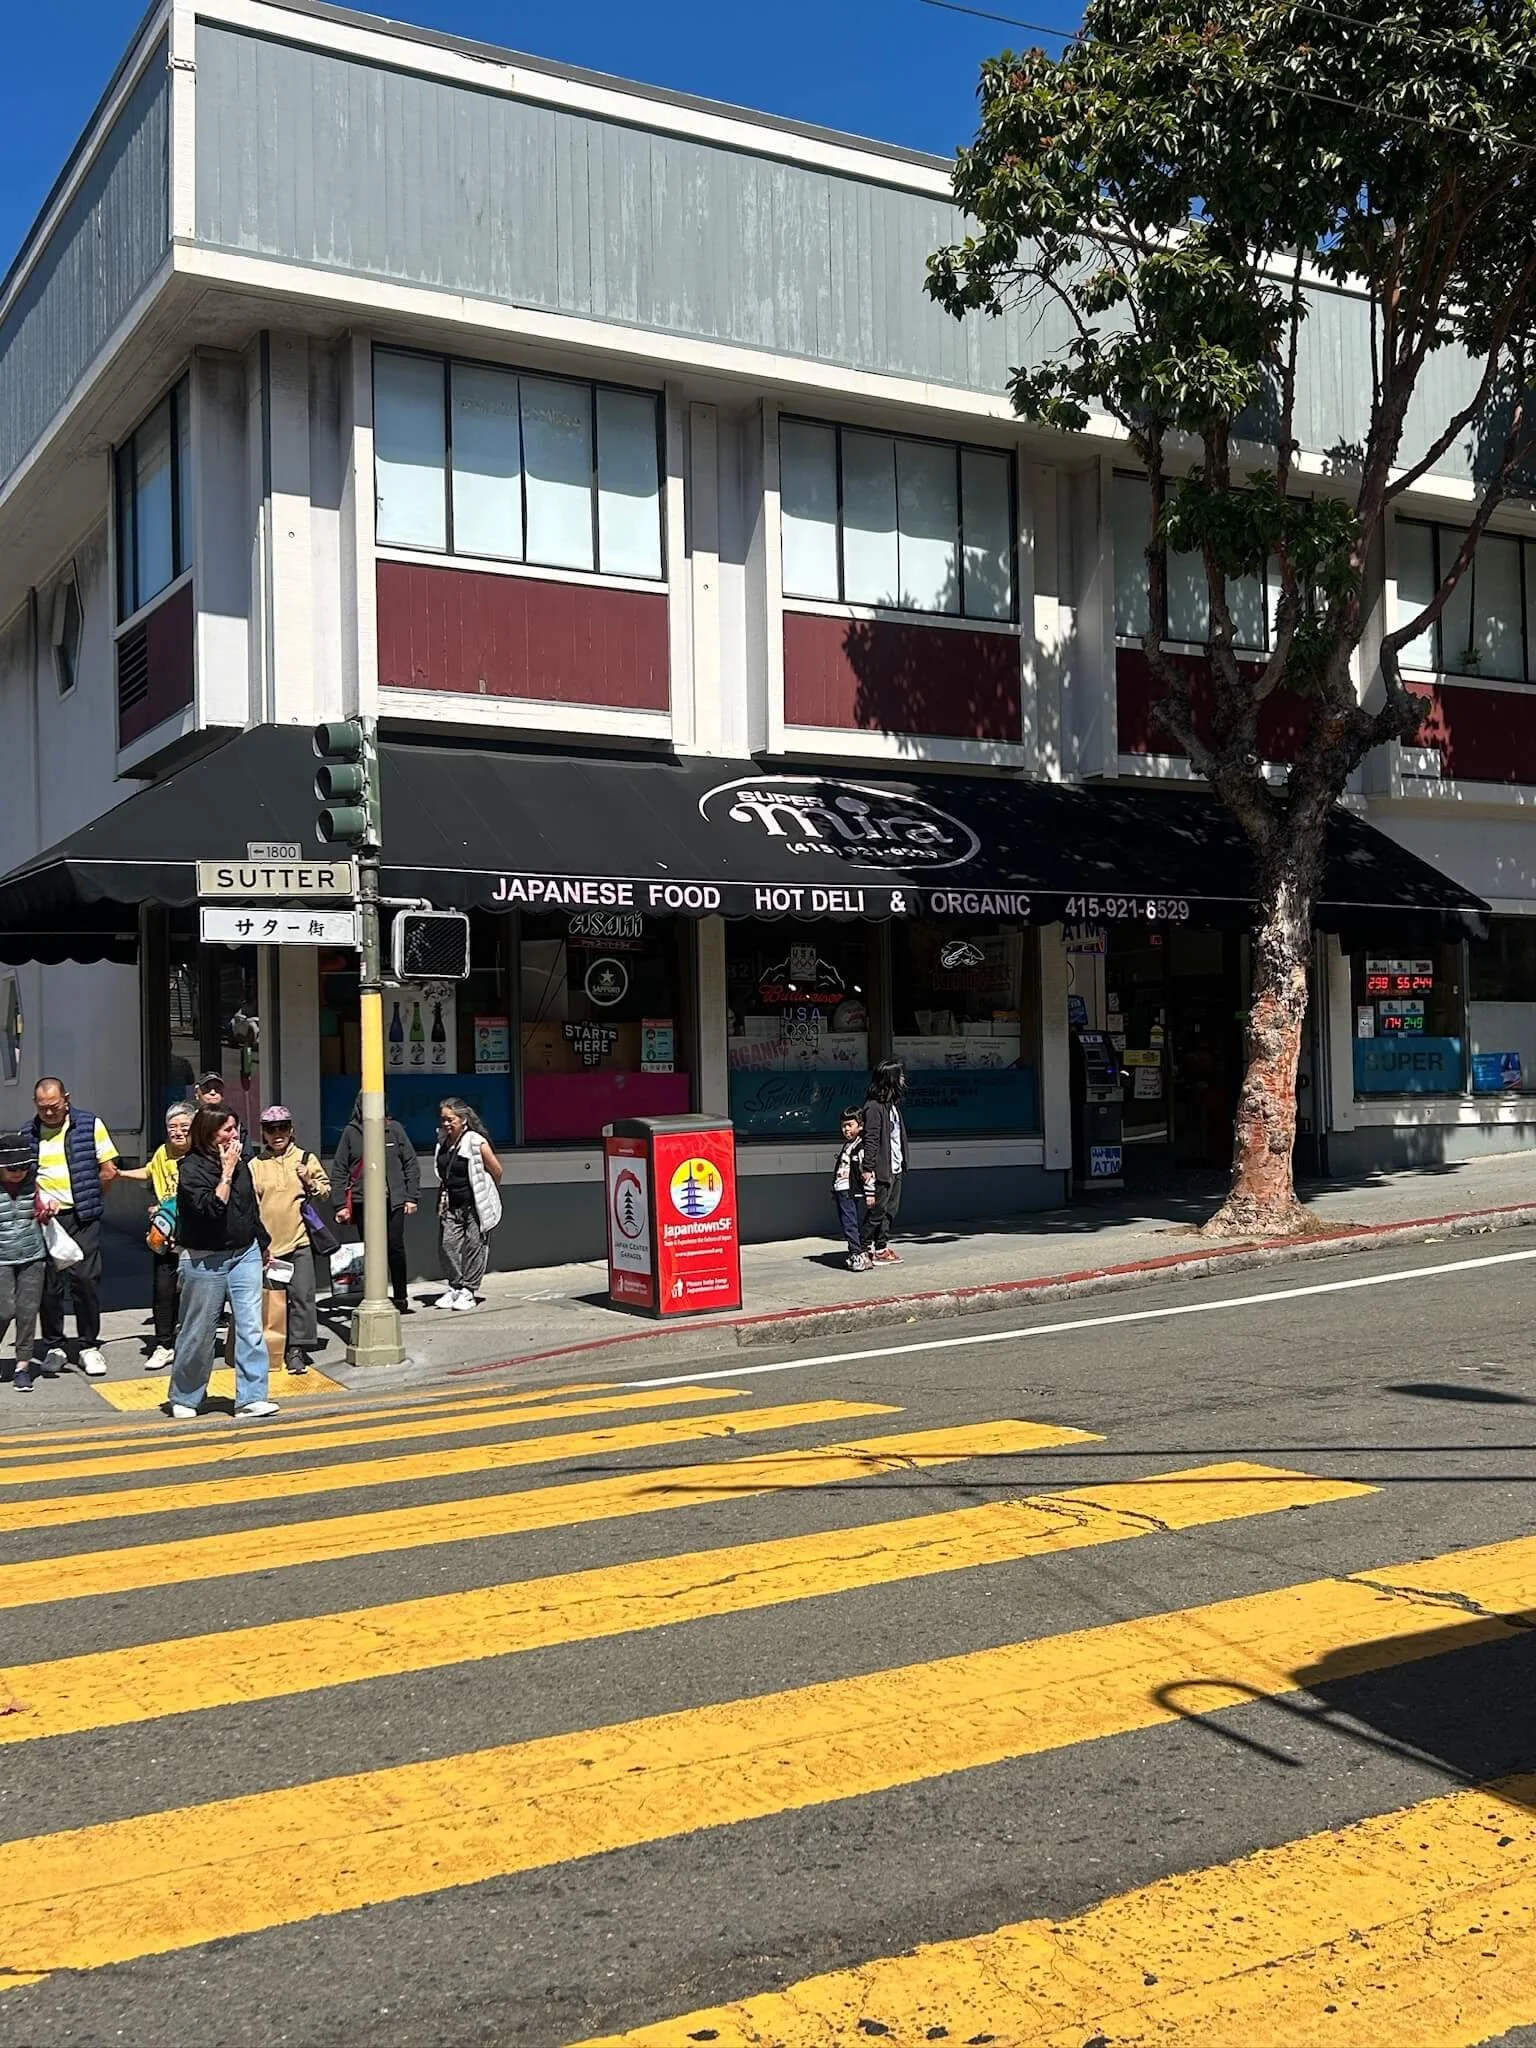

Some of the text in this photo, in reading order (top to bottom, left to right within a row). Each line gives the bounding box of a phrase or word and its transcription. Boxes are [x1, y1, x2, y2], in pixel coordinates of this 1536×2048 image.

[736, 790, 826, 808] SUPER
[267, 846, 296, 858] 1800
[786, 842, 938, 859] (415) 921-6529
[217, 869, 335, 888] SUTTER
[492, 878, 1190, 920] JAPANESE FOOD HOT DELI & ORGANIC 415-921-6529
[235, 918, 325, 937] サター街
[783, 1007, 821, 1021] USA
[1403, 1017, 1423, 1029] 249
[565, 1025, 617, 1040] STARTS
[574, 1040, 609, 1053] HERE
[584, 1053, 600, 1065] SF
[1366, 1052, 1443, 1072] SUPER
[1094, 1160, 1121, 1173] ATM
[664, 1218, 732, 1239] JapantownSF
